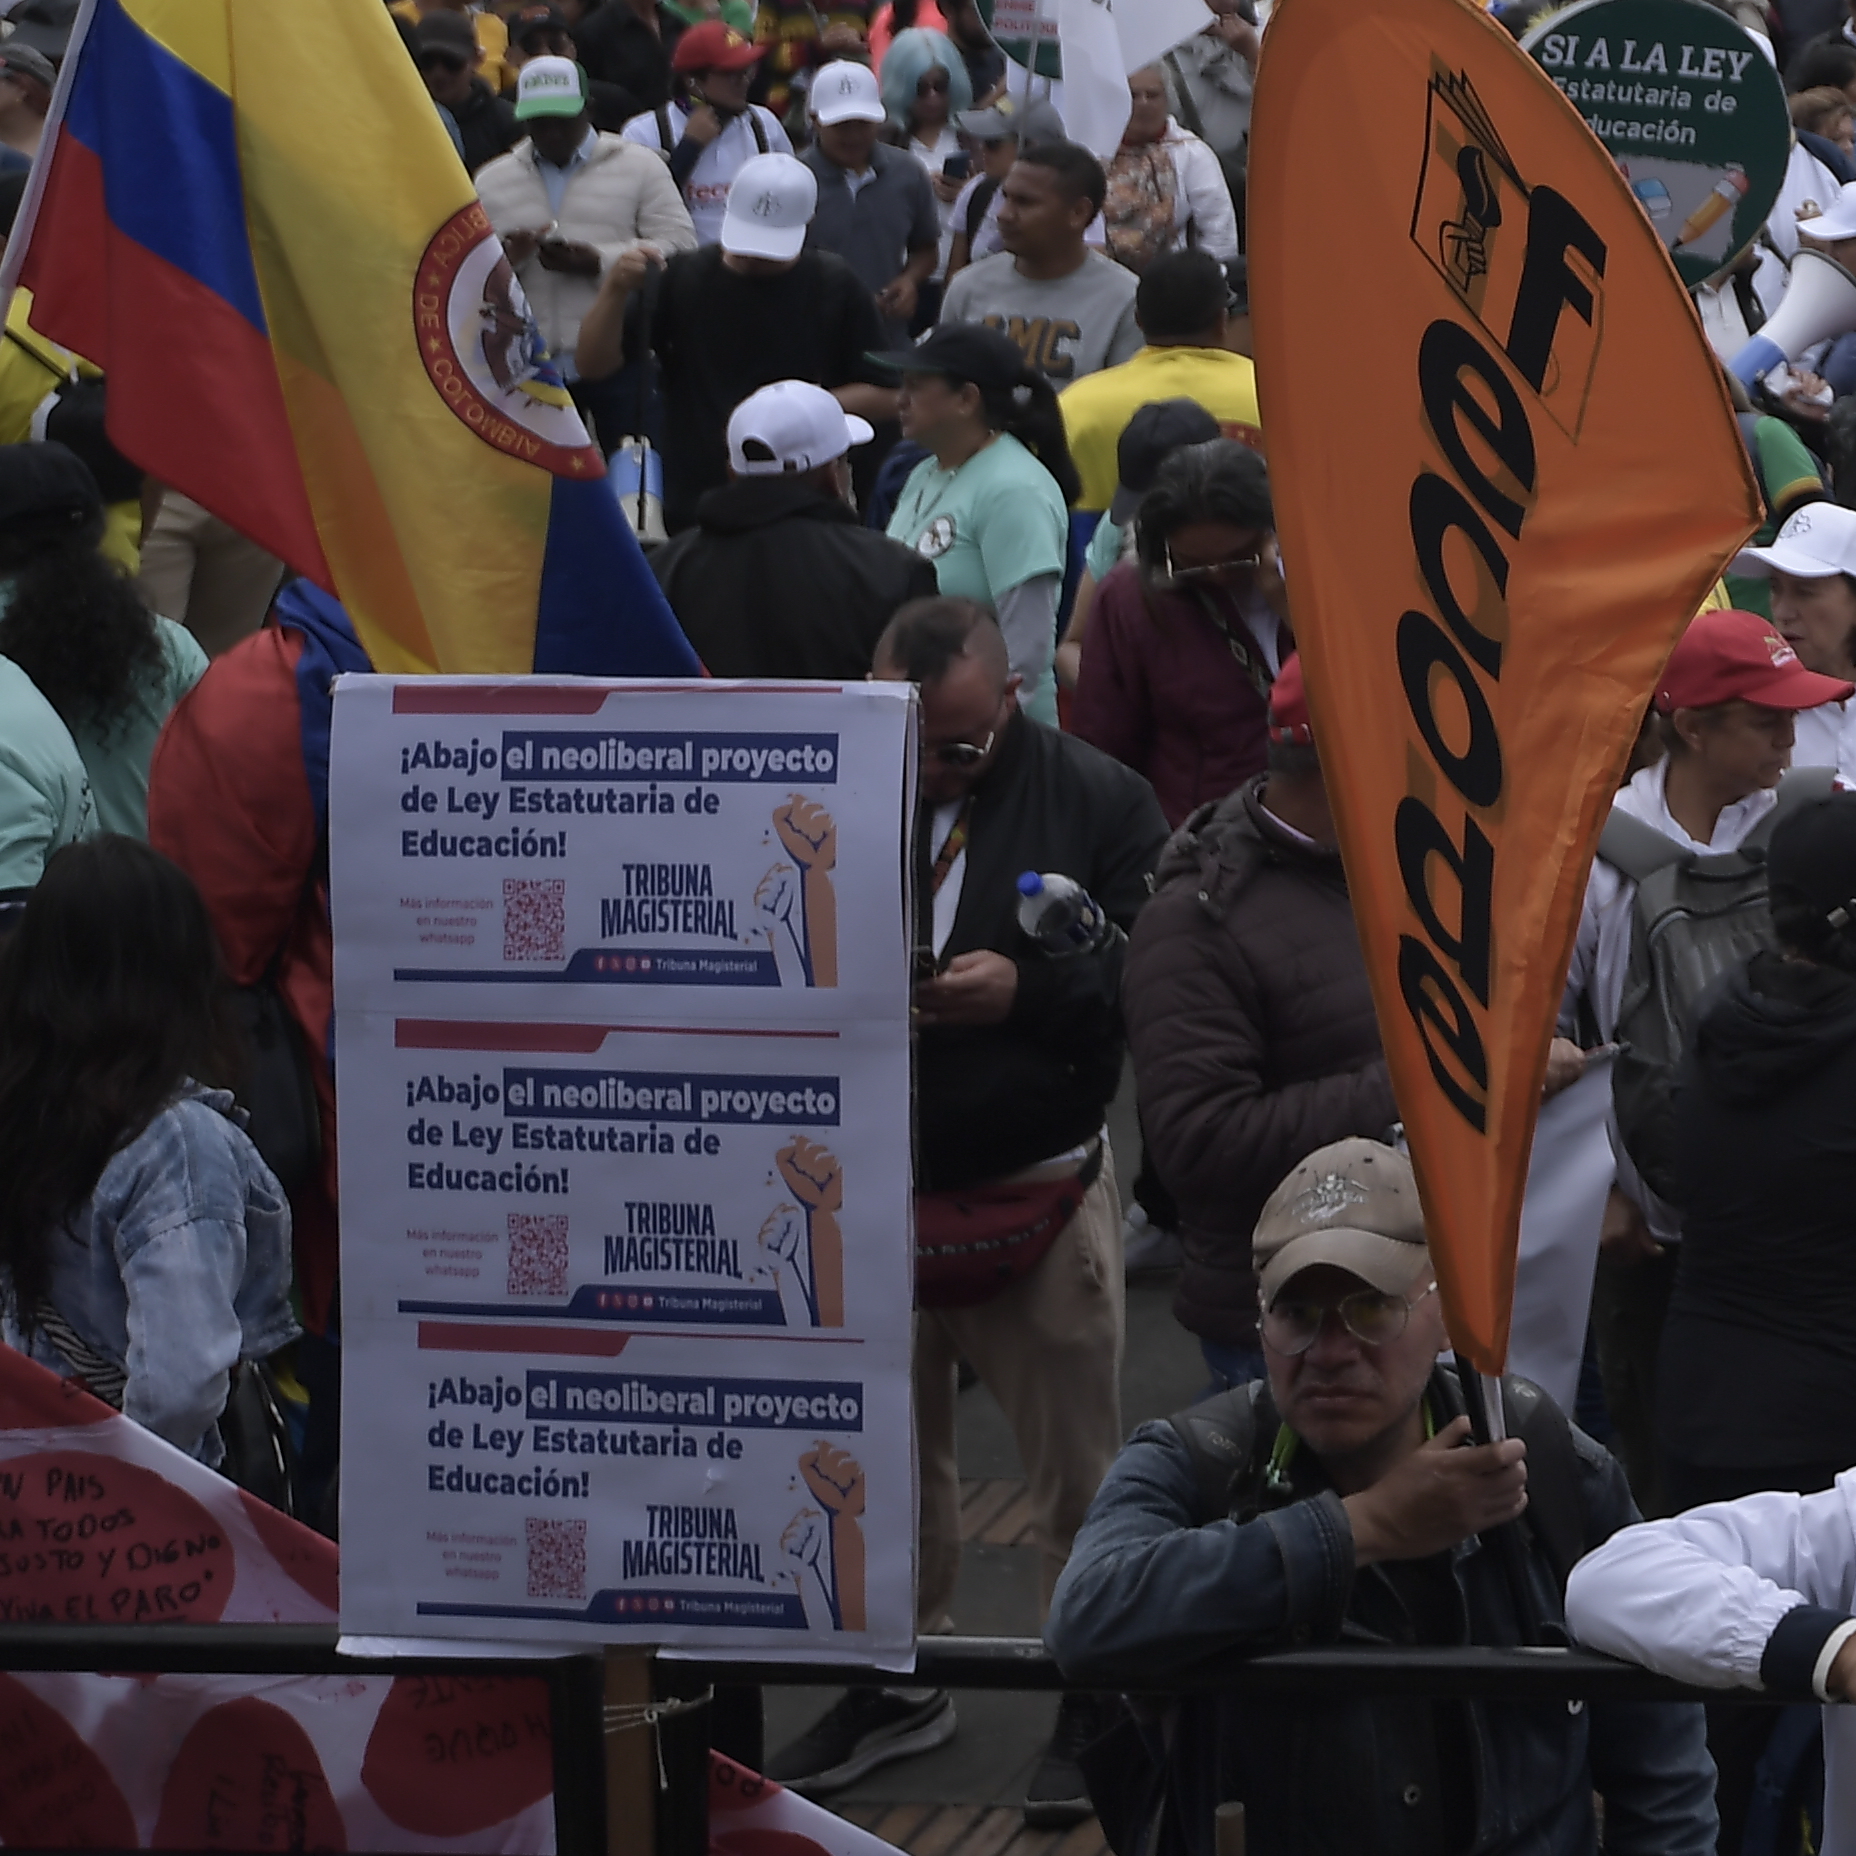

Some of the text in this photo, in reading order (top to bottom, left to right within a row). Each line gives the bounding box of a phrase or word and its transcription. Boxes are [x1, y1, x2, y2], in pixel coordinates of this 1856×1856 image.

[1542, 33, 1753, 82] SI A LA LEY
[1553, 76, 1738, 113] Estatutaria de
[983, 315, 1083, 377] MC
[1396, 183, 1607, 1134] fecode
[401, 739, 834, 777] ¡Abajo el neoliberal proyecto
[401, 784, 720, 820] de Ley Estatutaria de
[401, 828, 567, 858] Educación!
[622, 864, 713, 897] TRIBUNA
[400, 897, 493, 911] Más información
[416, 915, 477, 927] en nuestro
[600, 898, 738, 941] MAGISTERIAL
[420, 932, 474, 947] whatsapp
[656, 959, 757, 974] Tribuna Magisterial
[406, 1075, 836, 1120] ¡Abajo el neoliberal proyecto
[407, 1119, 721, 1155] de Ley Estatutaria de
[408, 1162, 569, 1194] Educación!
[624, 1201, 715, 1236] TRIBUNA
[430, 1229, 499, 1243] información
[423, 1248, 482, 1261] en nuestro
[604, 1235, 743, 1280] MAGISTERIAL
[658, 1296, 762, 1312] Tribuna Magisterial
[429, 1376, 859, 1424] ¡Abajo el neoliberal proyecto
[428, 1420, 743, 1460] de Ley Estatutaria de
[47, 1466, 105, 1503] PAIS
[429, 1465, 590, 1498] Educación!
[451, 1532, 517, 1546] información
[646, 1505, 738, 1539] TRIBUNA
[464, 1551, 501, 1563] nuestro
[623, 1539, 764, 1583] MAGISTERIAL
[680, 1599, 784, 1616] Tribuna Magisterial
